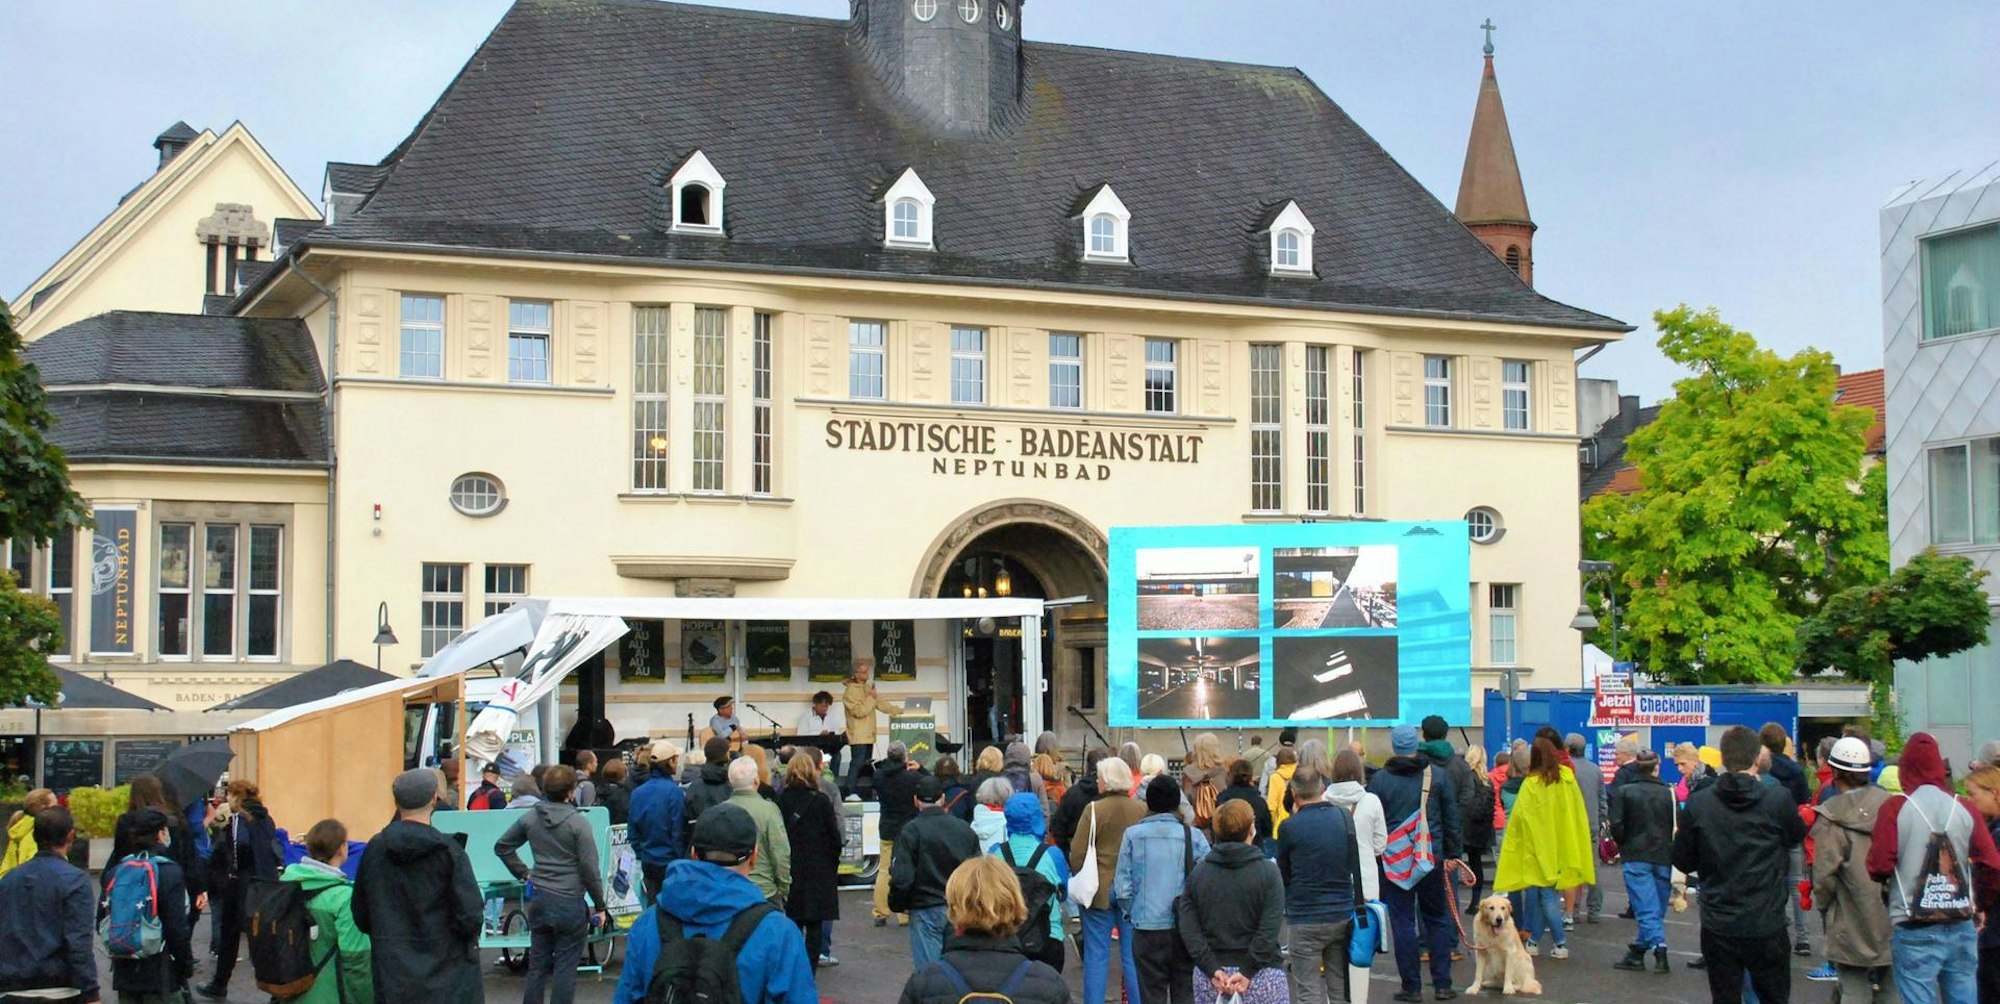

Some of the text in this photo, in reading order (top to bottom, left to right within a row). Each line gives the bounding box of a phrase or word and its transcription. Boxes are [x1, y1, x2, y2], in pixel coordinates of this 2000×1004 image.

[826, 418, 996, 454] STÄDTISCHE
[1020, 427, 1204, 463] BADEANSTALT
[932, 457, 1111, 481] NEPTUNBAD
[115, 527, 130, 644] NEPTUNBAD
[634, 631, 649, 640] AU
[887, 631, 901, 639] AU
[628, 640, 643, 649] AU
[881, 638, 895, 647] AU
[635, 649, 650, 658] AU
[887, 648, 901, 656] AU
[629, 658, 644, 667] AU
[882, 656, 896, 664] AU
[635, 667, 650, 676] AU
[888, 664, 902, 673] AU
[175, 693, 215, 702] BADEN
[1599, 695, 1632, 707] Jetzt!
[1641, 697, 1705, 713] Checkpoint
[891, 722, 934, 730] EHRENFELD
